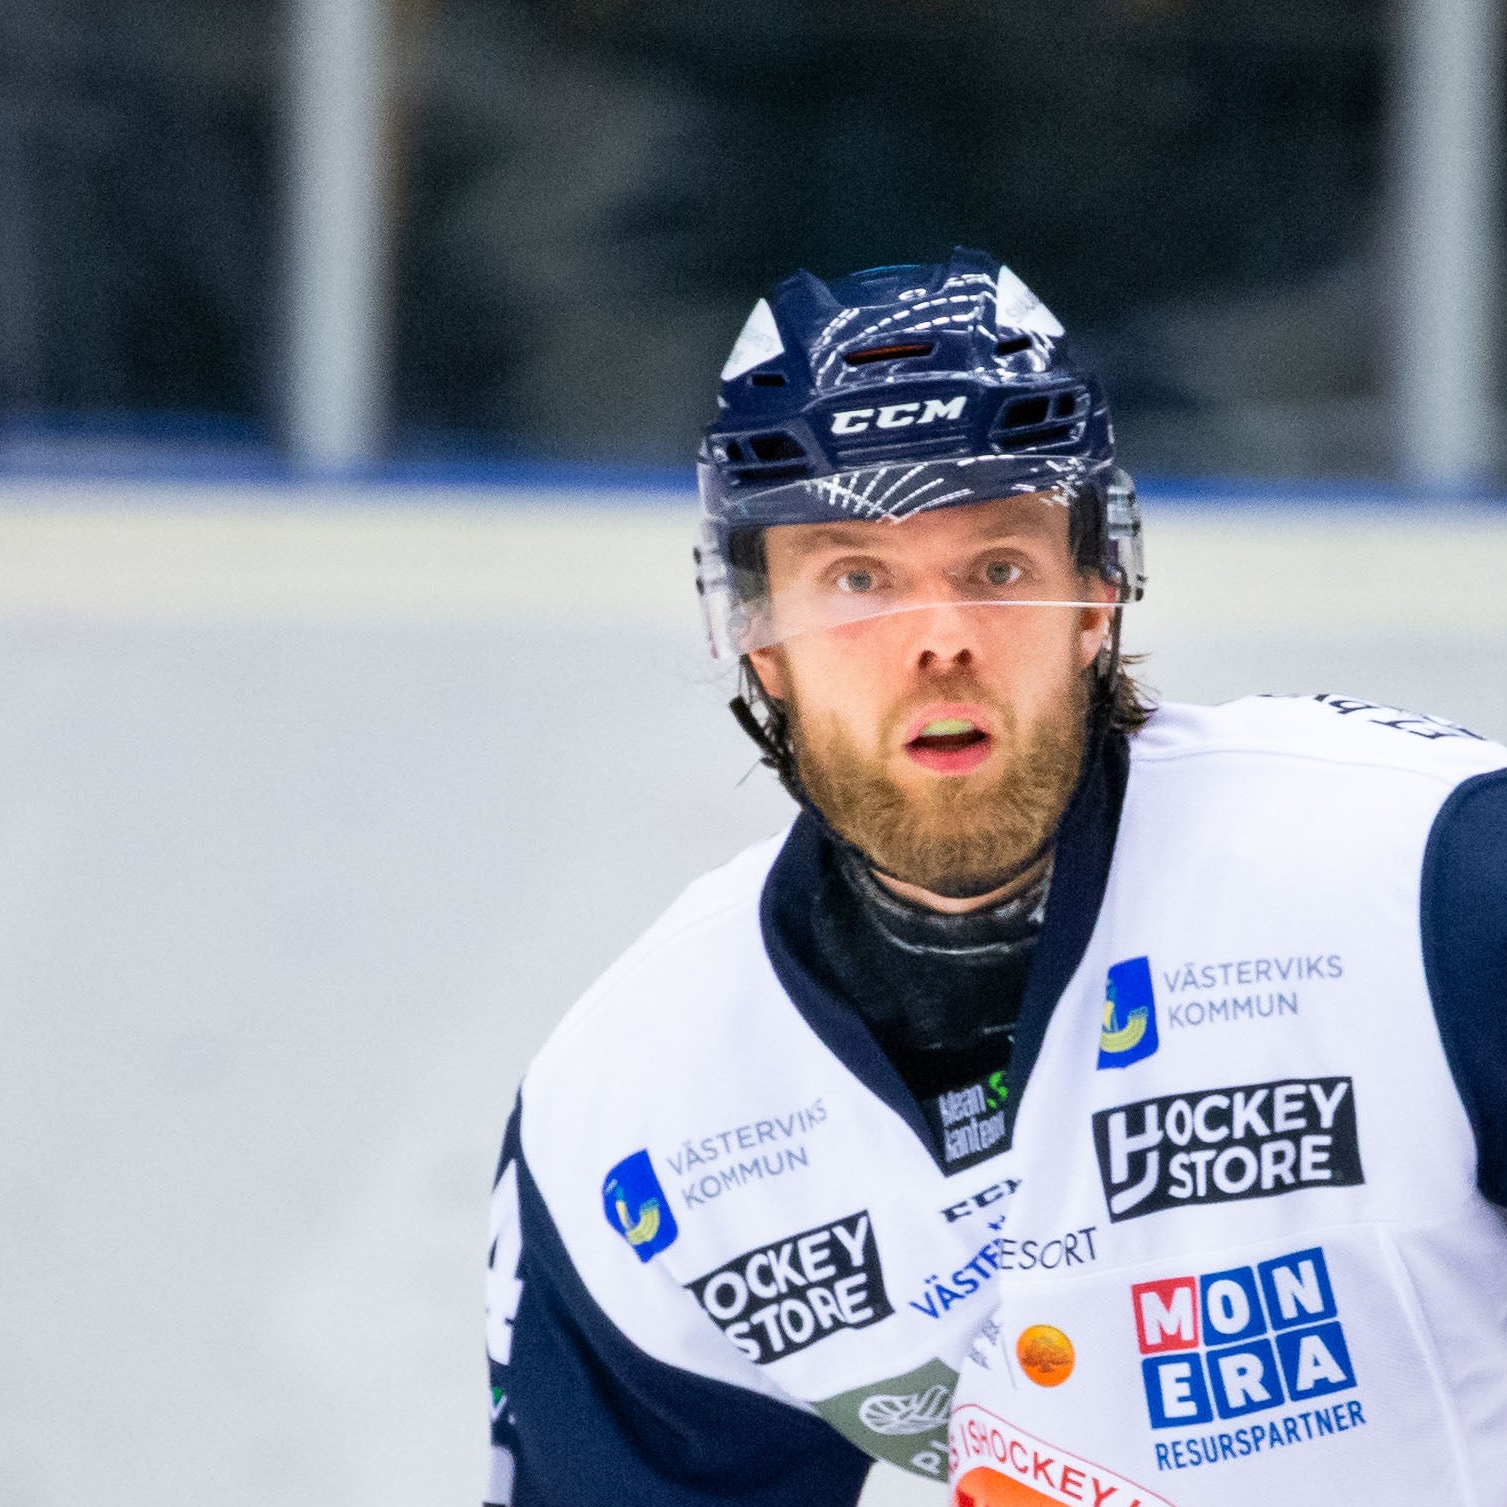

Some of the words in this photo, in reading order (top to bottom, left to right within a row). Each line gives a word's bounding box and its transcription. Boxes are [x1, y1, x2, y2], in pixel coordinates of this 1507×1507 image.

[831, 395, 968, 435] CCM
[1162, 955, 1344, 993] VÄSTERVIKS
[1167, 992, 1300, 1029] KOMMUN
[665, 1097, 828, 1178] VÄSTERVIKS
[1108, 1081, 1350, 1202] HOCKEY
[1168, 1135, 1333, 1200] STORE
[681, 1145, 810, 1210] KOMMUN
[702, 1215, 869, 1321] OCKEY
[999, 1227, 1097, 1270] ESORT
[720, 1272, 873, 1360] STORE
[1154, 1400, 1368, 1472] RESURSPARTNER
